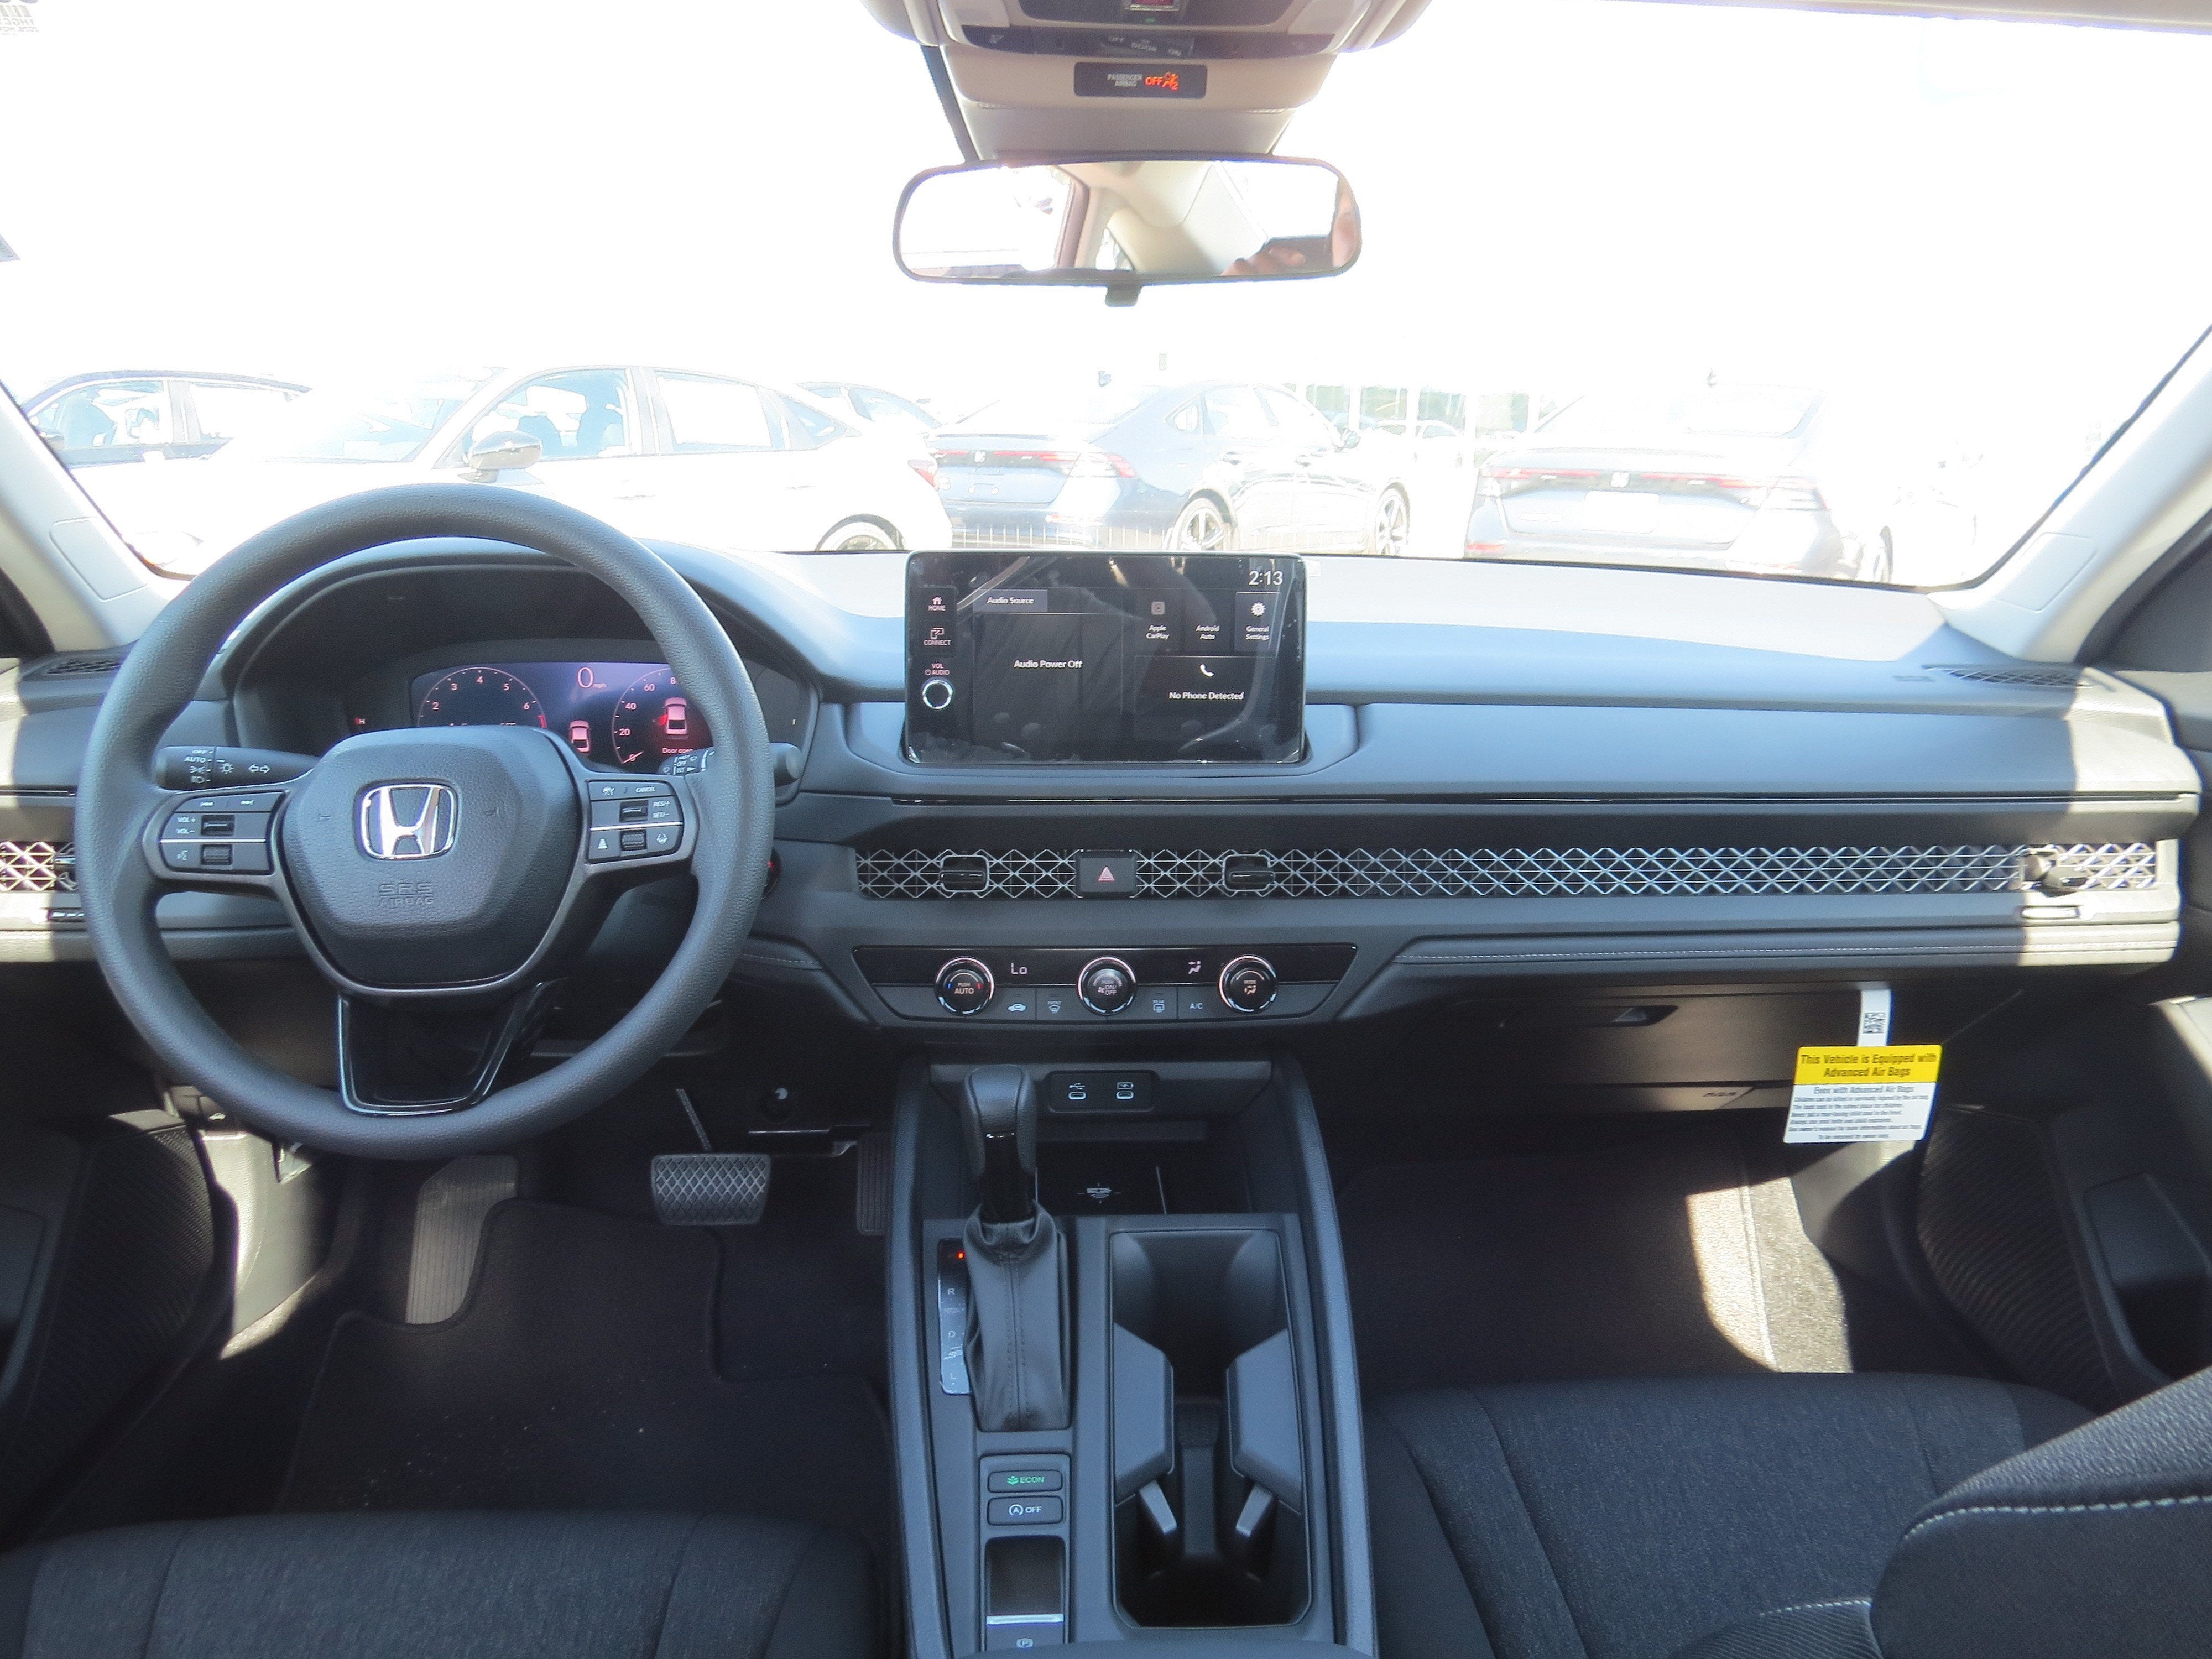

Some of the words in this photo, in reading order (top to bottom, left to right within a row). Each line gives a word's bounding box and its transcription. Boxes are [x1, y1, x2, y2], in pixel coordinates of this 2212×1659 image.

[1145, 76, 1164, 86] OFF
[1248, 570, 1283, 586] 2:13
[476, 676, 483, 684] 4
[577, 667, 593, 688] 0
[451, 683, 458, 691] 3
[503, 683, 510, 691] 5
[432, 702, 439, 711] 2
[523, 702, 530, 711] 6
[624, 702, 637, 711] 40
[619, 728, 630, 736] 20
[379, 882, 432, 894] SRS
[380, 896, 434, 906] AIRBAG
[1010, 962, 1027, 974] Lo
[1801, 1055, 1820, 1064] This
[1823, 1054, 1858, 1064] Vehicle
[1861, 1055, 1870, 1063] is
[1871, 1053, 1916, 1065] Equipped
[1918, 1053, 1937, 1062] with
[1824, 1067, 1869, 1077] Advanced
[1872, 1067, 1886, 1076] Air
[1887, 1067, 1911, 1077] Bags
